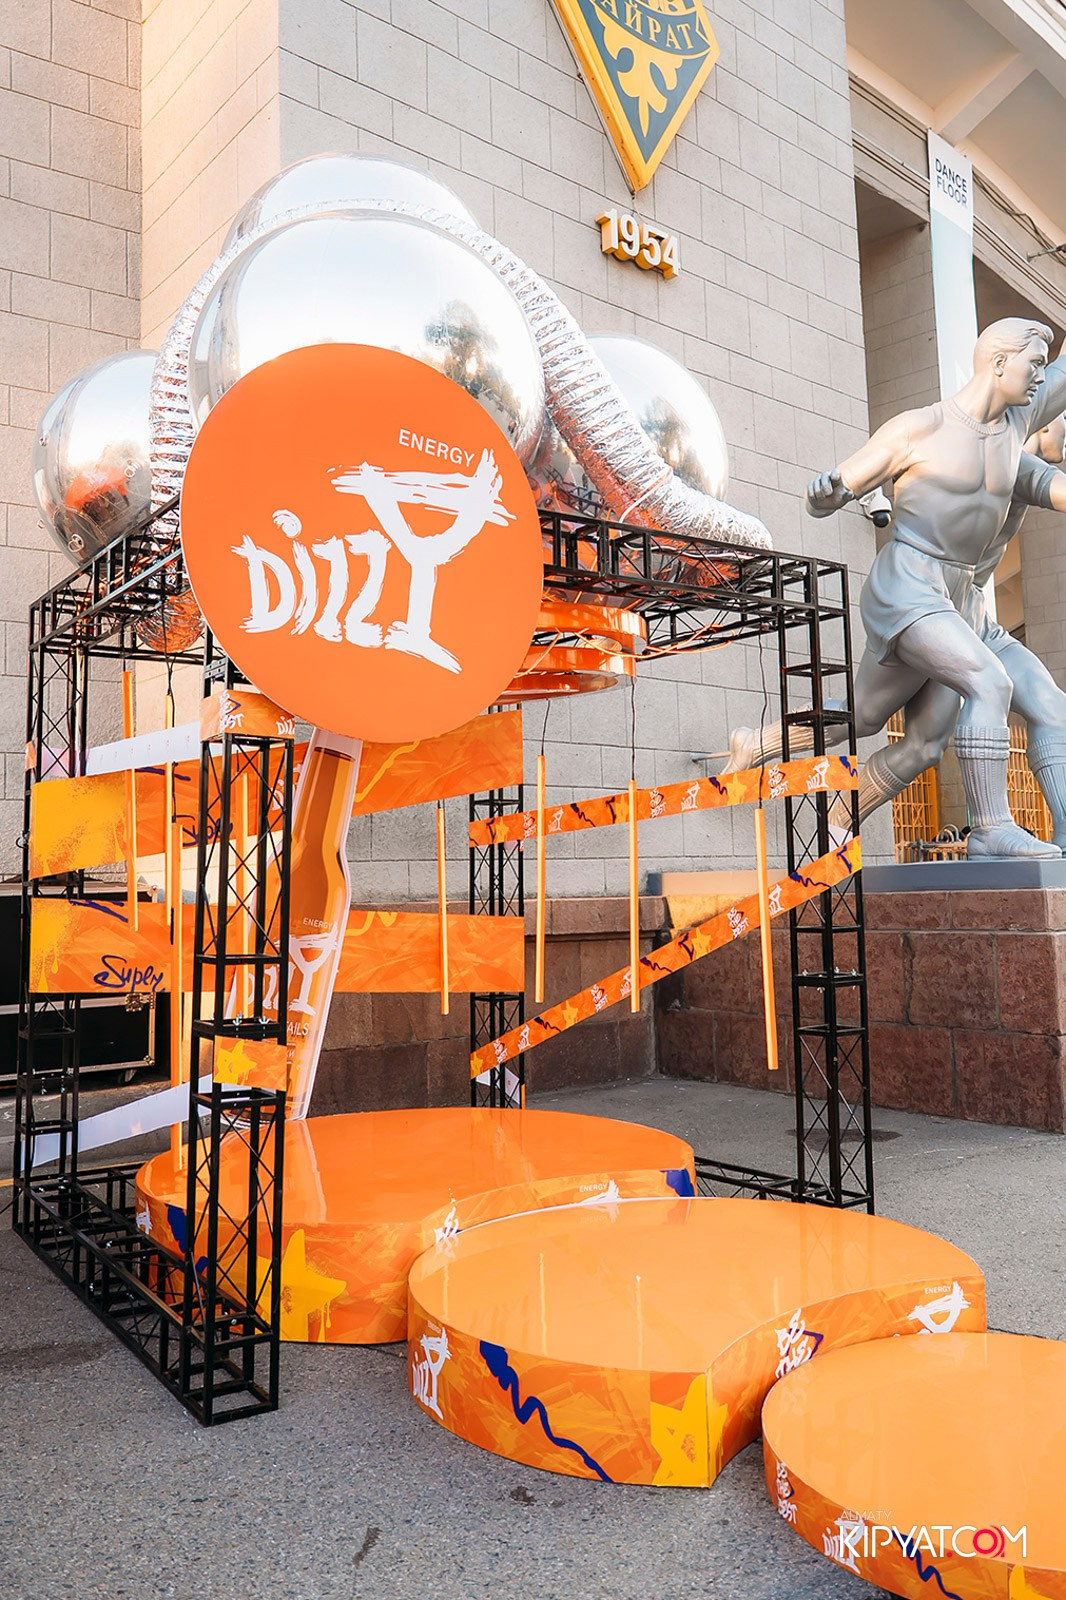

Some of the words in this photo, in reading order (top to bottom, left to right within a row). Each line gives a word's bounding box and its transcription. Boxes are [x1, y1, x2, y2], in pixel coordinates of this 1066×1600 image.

[935, 158, 967, 193] DANCE
[936, 175, 967, 208] FLOOR
[603, 208, 679, 277] 1954
[398, 428, 475, 467] ENERGY
[303, 917, 332, 929] ENERGY
[579, 1183, 607, 1193] ENERGY
[924, 1286, 952, 1295] ENERGY
